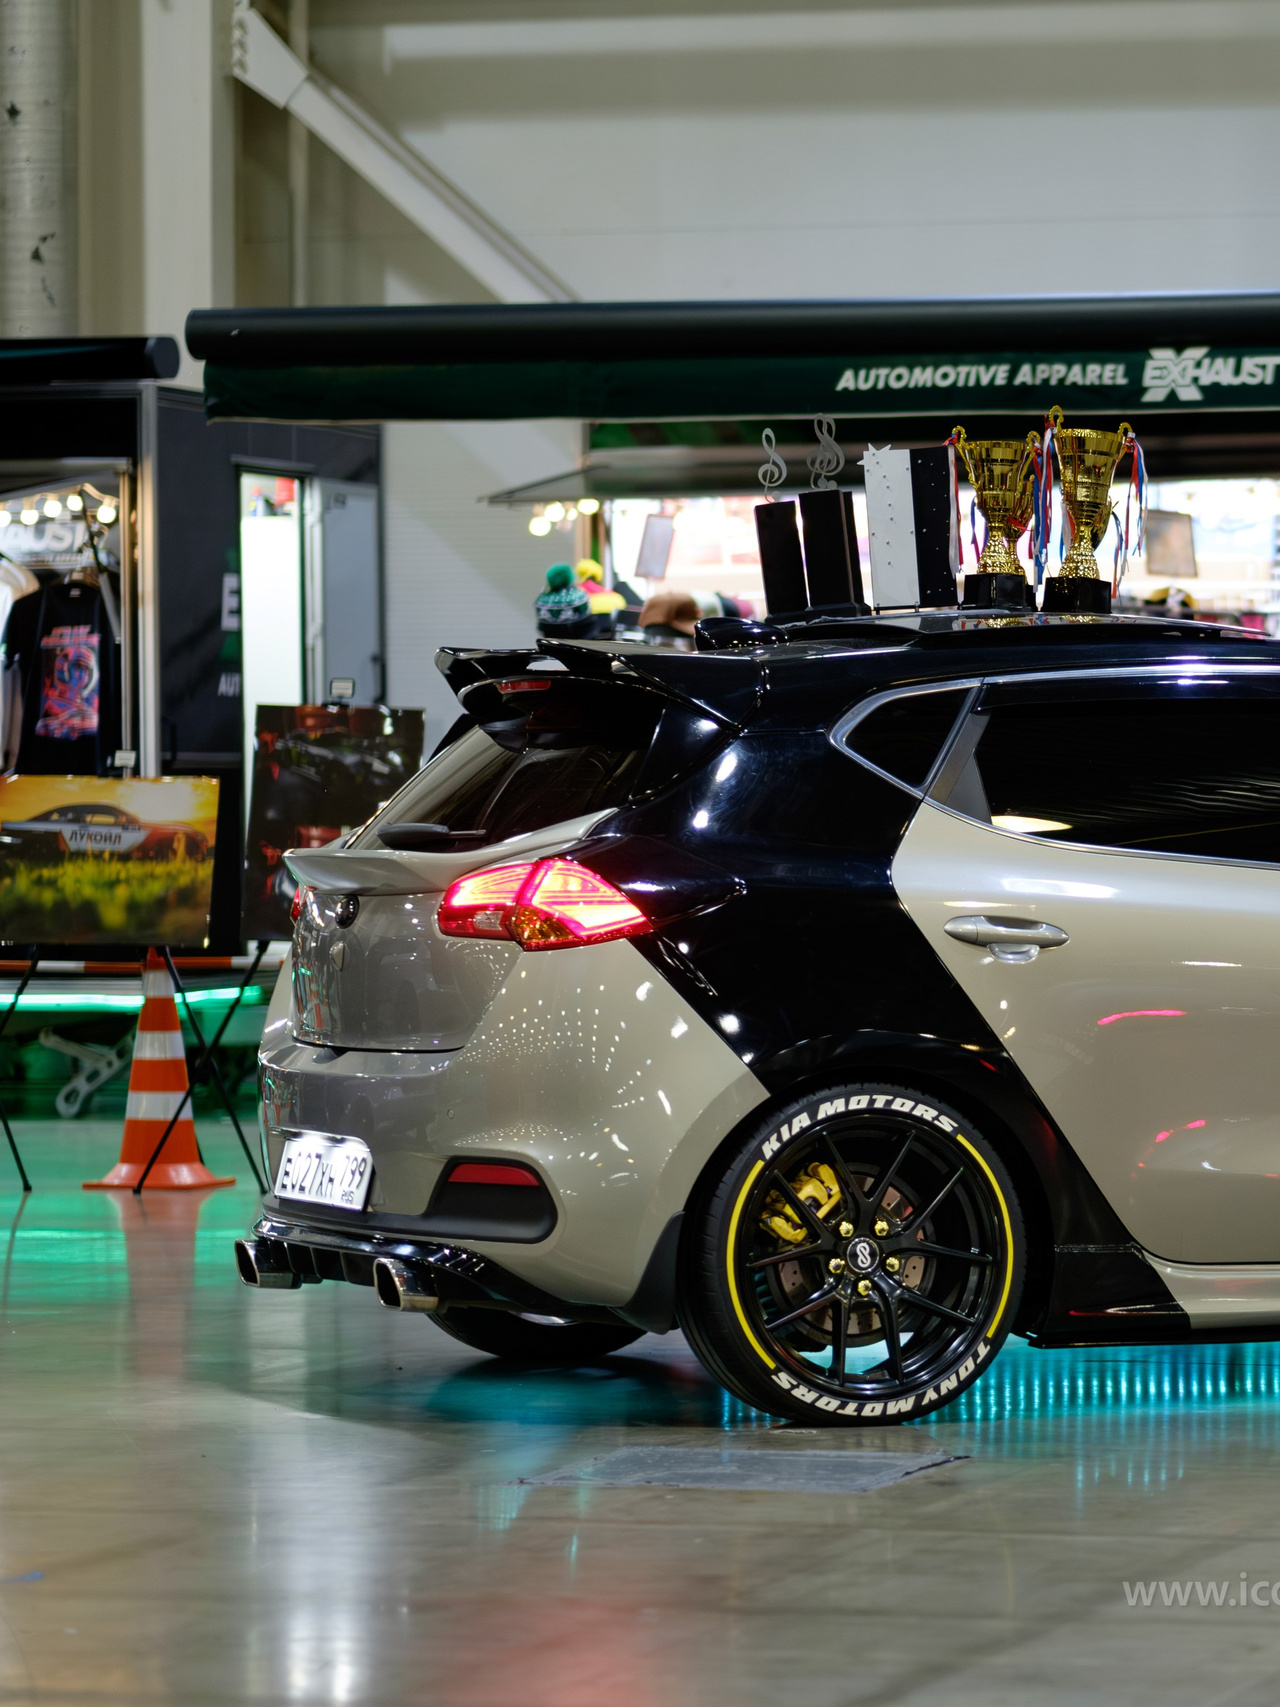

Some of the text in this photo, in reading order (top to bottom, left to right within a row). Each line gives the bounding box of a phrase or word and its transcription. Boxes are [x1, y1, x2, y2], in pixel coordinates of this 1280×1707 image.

[836, 364, 1010, 391] AUTOMOTIVE
[1013, 363, 1128, 387] APPAREL
[760, 1094, 959, 1160] KIA MOTORS
[340, 1154, 368, 1190] 799
[771, 1343, 991, 1418] TONY MOTORS
